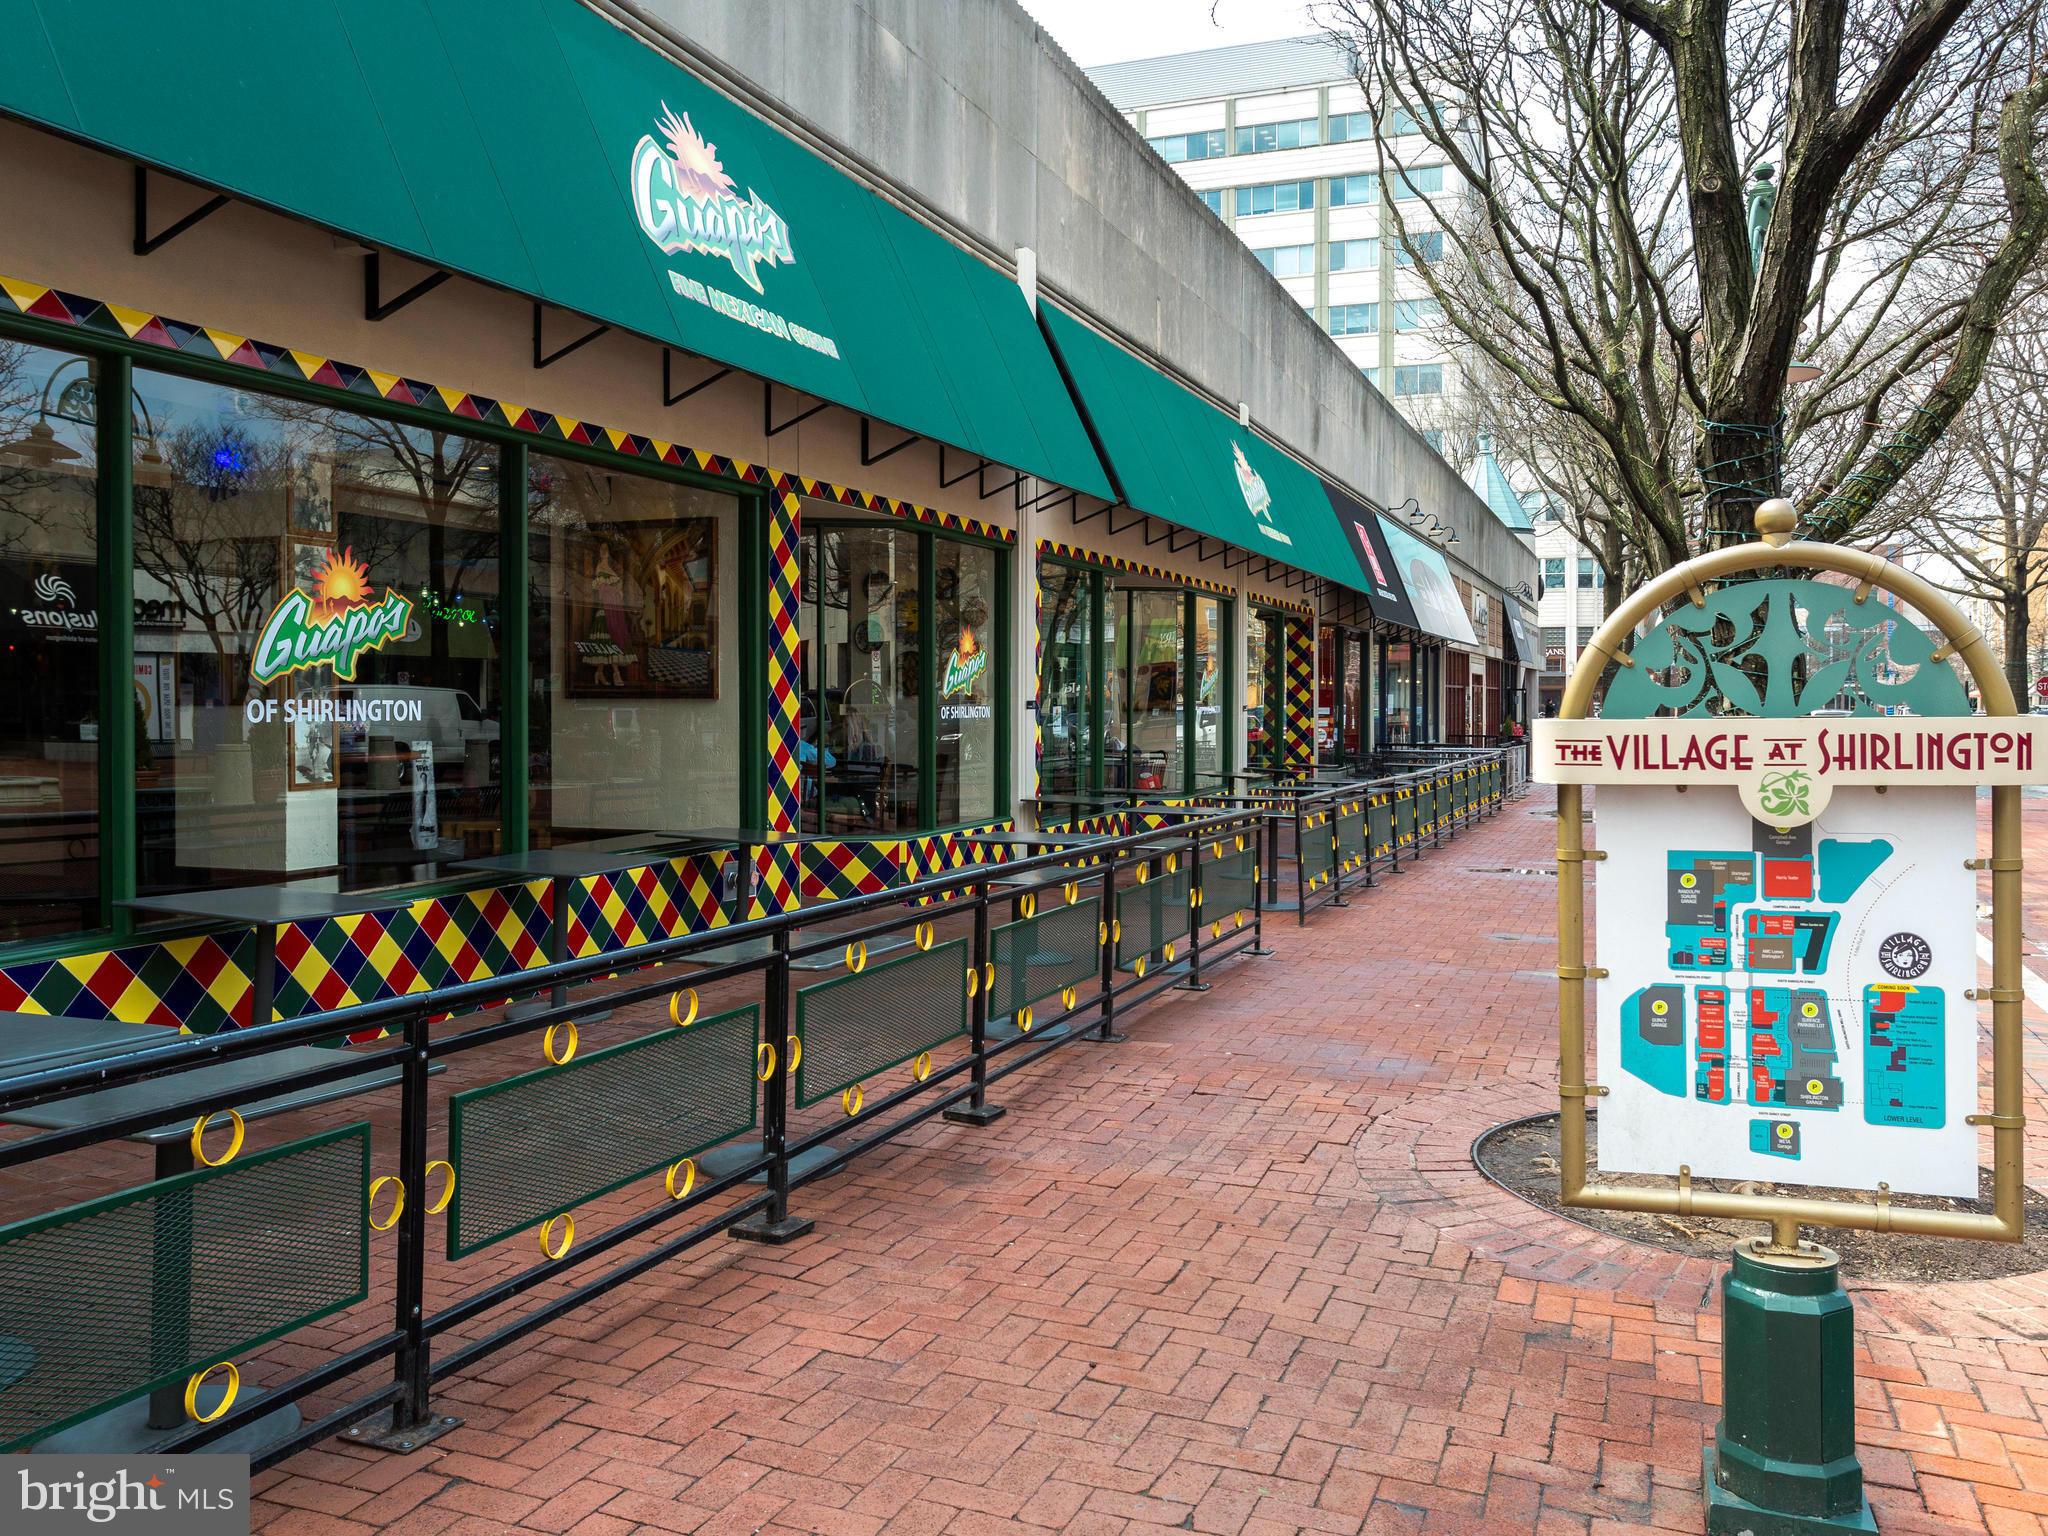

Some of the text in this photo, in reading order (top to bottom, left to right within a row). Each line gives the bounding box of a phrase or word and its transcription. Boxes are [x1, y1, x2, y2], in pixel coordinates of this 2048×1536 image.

[638, 146, 784, 278] Guapo's
[668, 269, 711, 307] FINE
[707, 286, 791, 341] MEXICAN
[255, 595, 406, 678] Guapo's
[943, 650, 986, 695] Guapo's
[247, 699, 422, 723] OF SHIRLINGTON
[941, 705, 991, 719] OF SHIRLINGTON
[1555, 728, 2032, 775] THE VILLAGE AT SHIRLINGTON
[1883, 934, 1926, 951] VILLAGE
[1881, 959, 1928, 977] SHIRLINGTON
[1906, 1116, 1923, 1124] LEVEL
